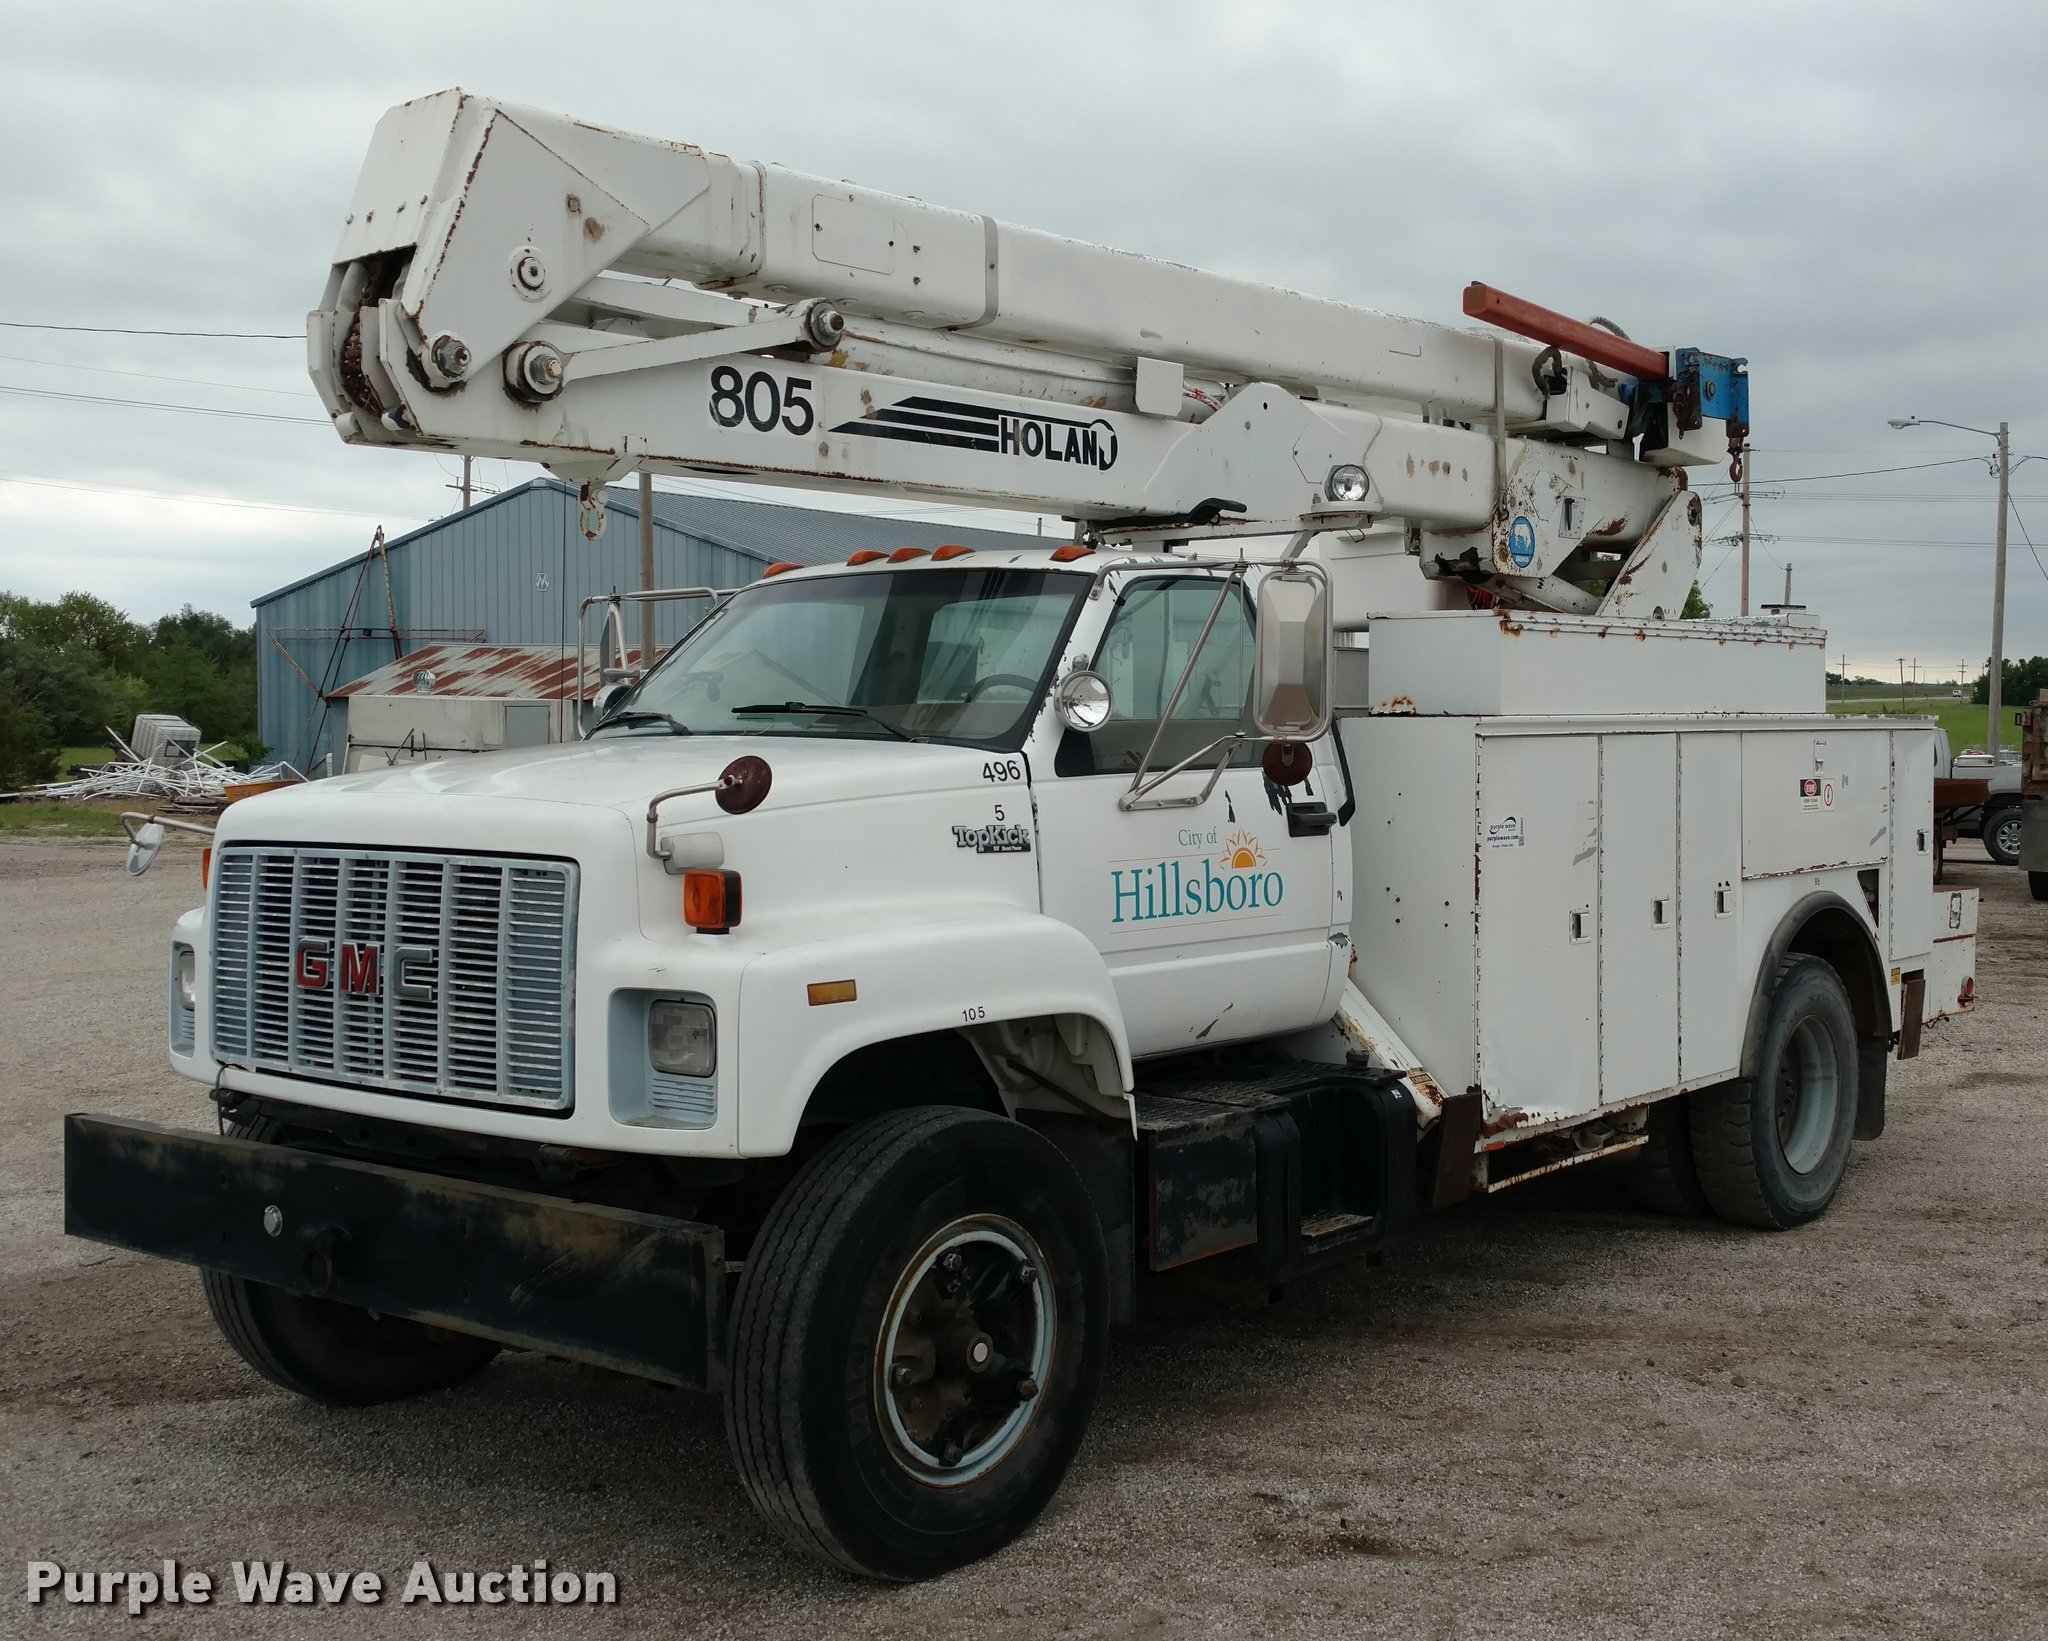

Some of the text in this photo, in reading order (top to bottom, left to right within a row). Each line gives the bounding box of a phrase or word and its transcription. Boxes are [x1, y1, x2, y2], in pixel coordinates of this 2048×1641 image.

[709, 365, 814, 436] 805
[982, 760, 1021, 783] 496
[994, 804, 1005, 821] 5
[952, 824, 1030, 853] TopKick
[1178, 826, 1218, 849] City of
[1110, 858, 1284, 923] Hillsboro
[296, 937, 433, 1001] GMC
[962, 1006, 985, 1022] 105
